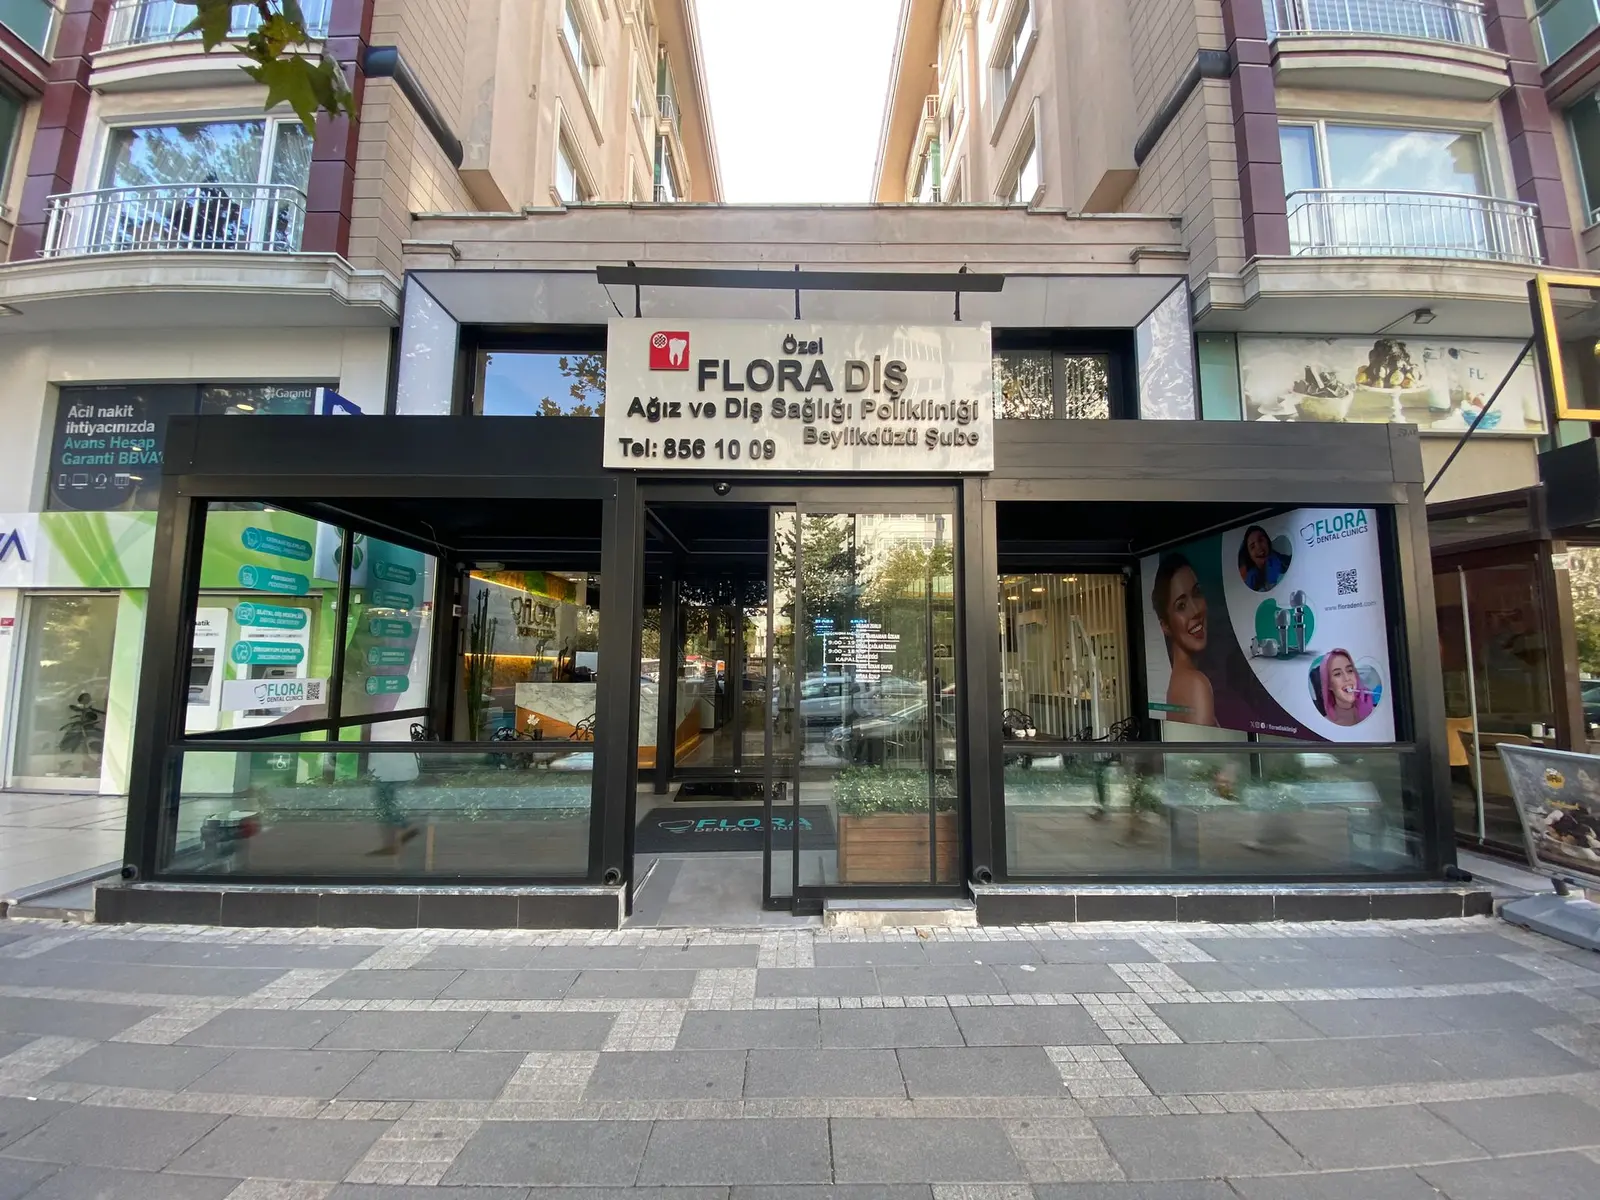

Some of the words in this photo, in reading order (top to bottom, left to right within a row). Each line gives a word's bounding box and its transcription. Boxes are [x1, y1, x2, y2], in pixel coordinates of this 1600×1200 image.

[782, 333, 824, 355] Özel
[697, 358, 834, 392] FLORA
[844, 354, 909, 399] DİŞ
[275, 387, 313, 400] Garanti
[67, 405, 94, 418] Acil
[97, 405, 134, 417] nakit
[627, 396, 682, 423] Ağız
[688, 402, 717, 419] ve
[725, 396, 764, 424] Diş
[771, 396, 853, 425] Sağlığı
[860, 398, 980, 424] Polikliniği
[65, 420, 155, 436] ihtiyacınızda
[64, 437, 106, 450] Avans
[109, 436, 155, 451] Hesap
[802, 425, 919, 450] Beylikdüzü
[924, 426, 980, 451] Şube
[618, 438, 658, 458] Tel:
[663, 437, 706, 459] 856
[714, 438, 741, 459] 10
[748, 438, 777, 459] 09
[62, 452, 114, 465] Garanti
[1315, 509, 1368, 536] FLORA
[1316, 533, 1341, 544] DENTAL
[1341, 525, 1368, 538] CLINICS
[0, 528, 31, 562] A
[267, 683, 304, 697] FLORA
[695, 817, 813, 828] FLORA
